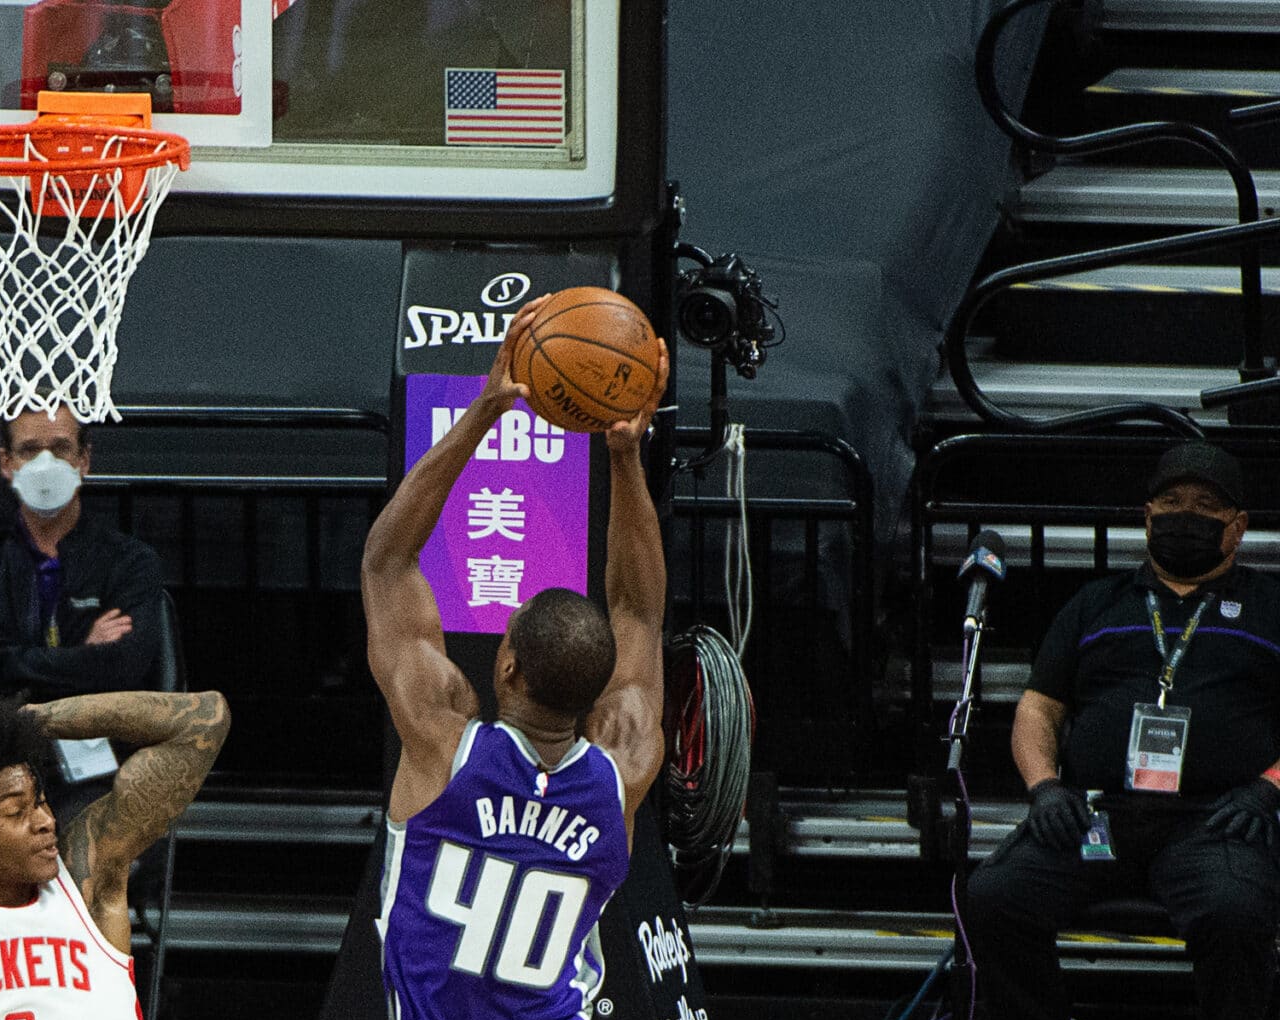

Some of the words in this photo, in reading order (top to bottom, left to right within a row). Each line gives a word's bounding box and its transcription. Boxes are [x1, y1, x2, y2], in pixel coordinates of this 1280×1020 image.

[467, 487, 526, 608] 美寶
[476, 796, 599, 861] BARNES
[427, 840, 591, 990] 40
[638, 915, 690, 983] Raley's
